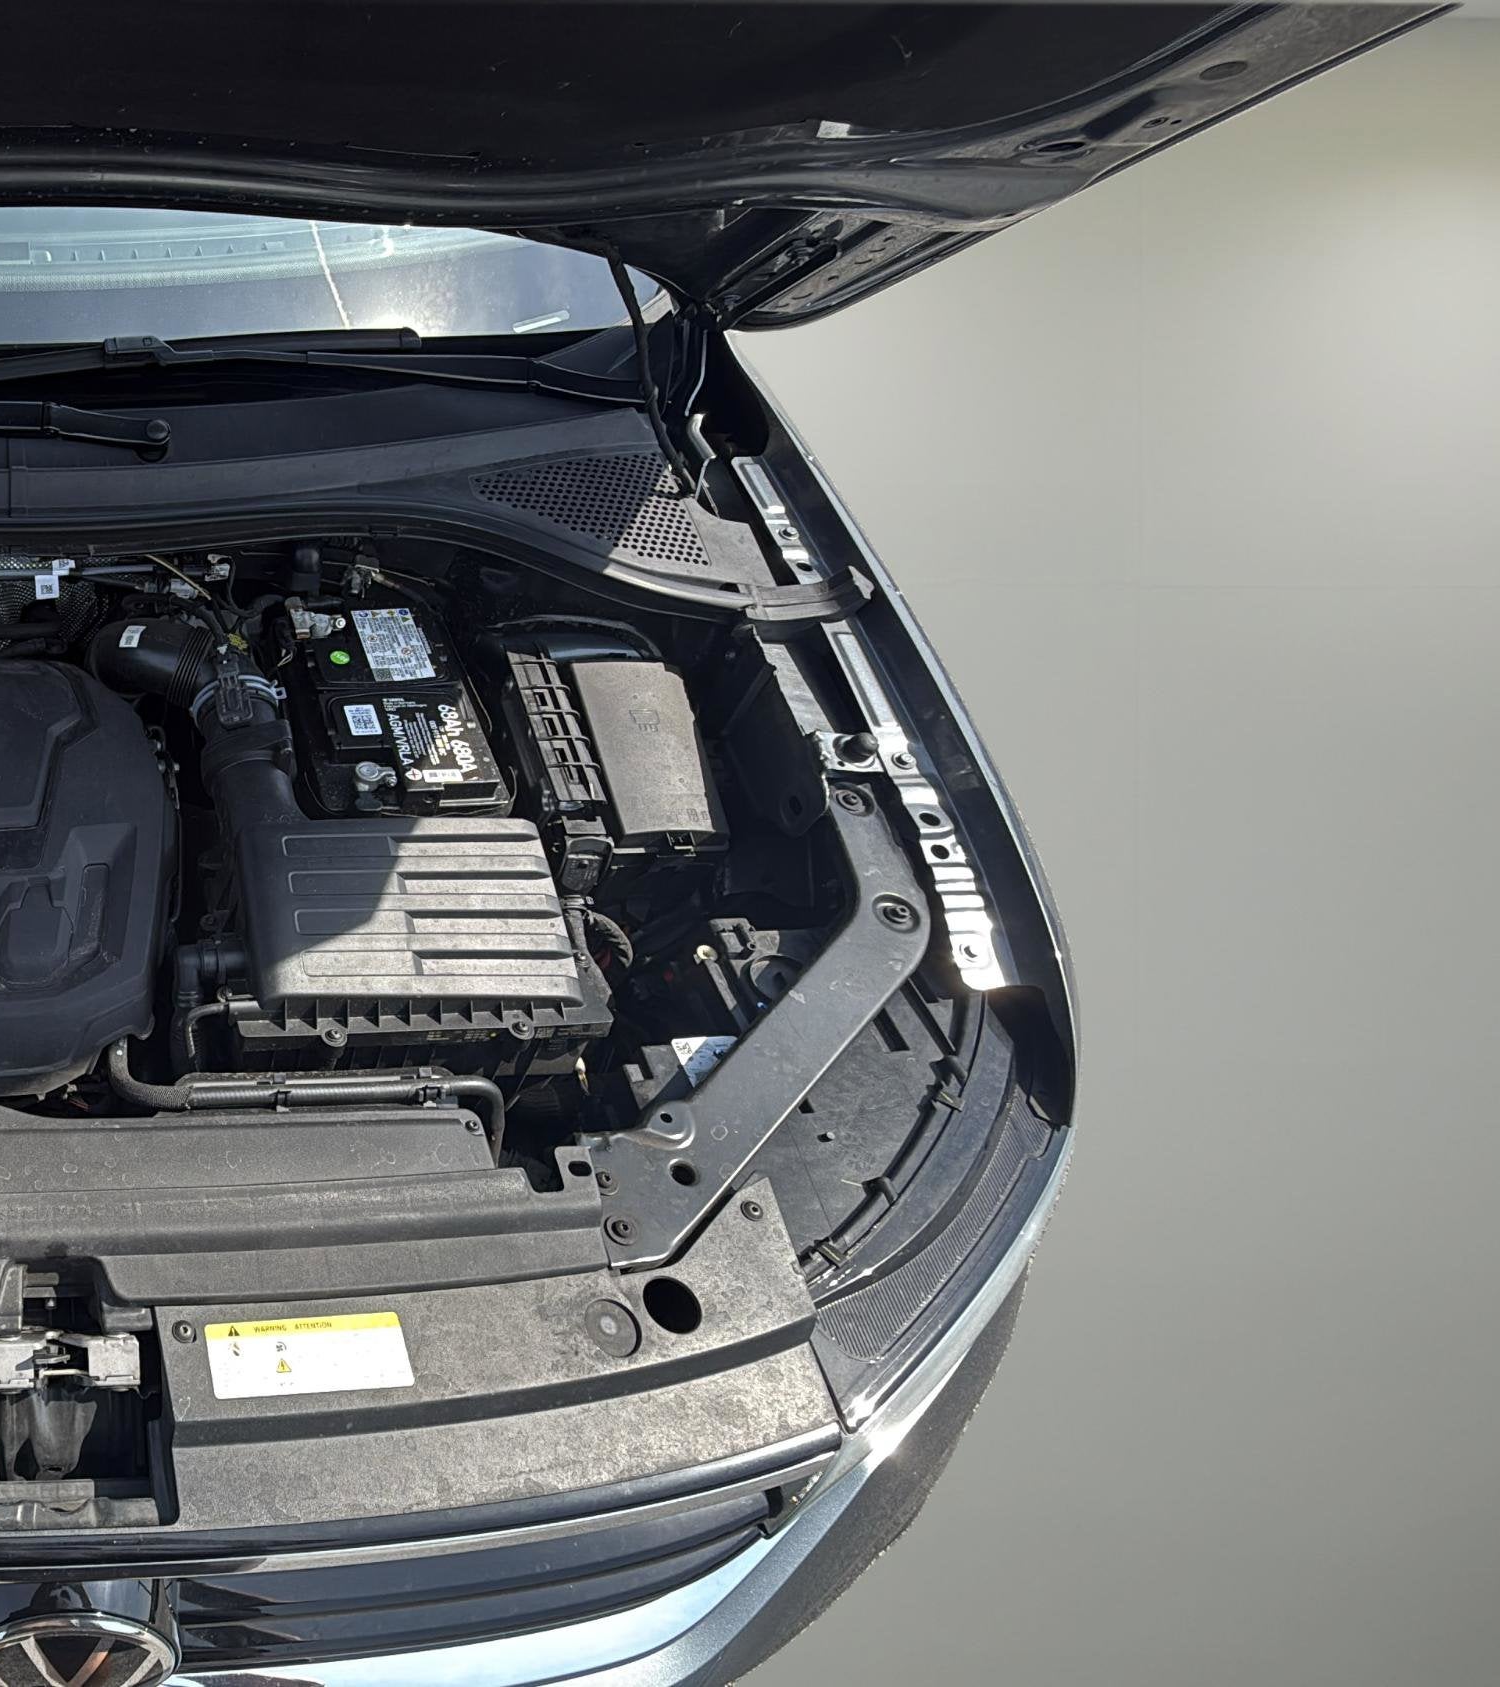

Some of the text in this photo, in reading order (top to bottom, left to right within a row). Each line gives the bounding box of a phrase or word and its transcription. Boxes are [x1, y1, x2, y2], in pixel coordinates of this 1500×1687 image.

[438, 704, 464, 737] 68Ah
[387, 713, 414, 766] AGM/VRLA
[450, 739, 478, 773] 680A
[253, 1321, 333, 1334] WARNING ATTENTION
